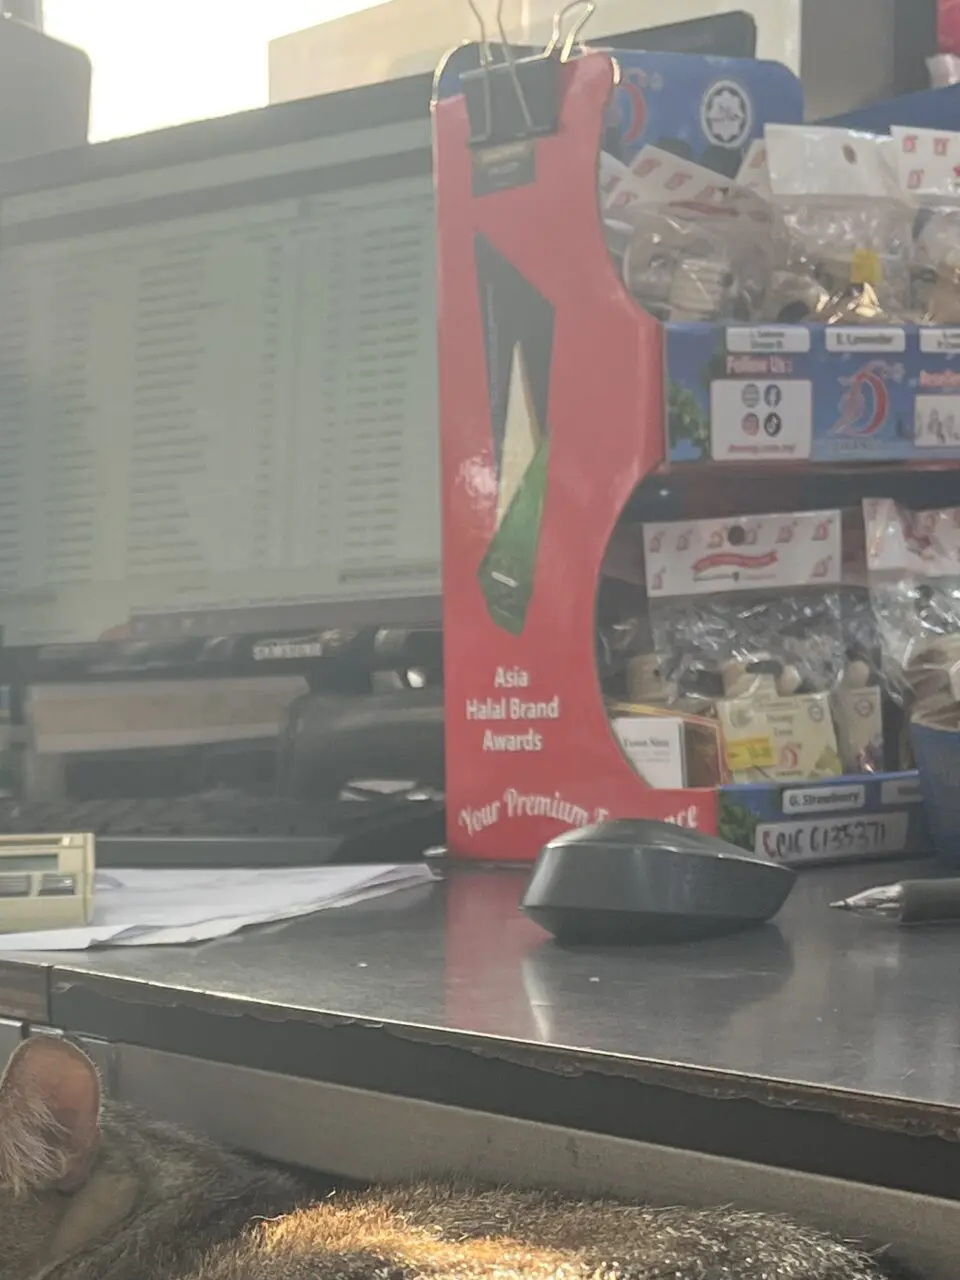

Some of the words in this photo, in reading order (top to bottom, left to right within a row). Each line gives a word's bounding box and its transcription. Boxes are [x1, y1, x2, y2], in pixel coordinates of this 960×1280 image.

[252, 642, 322, 661] SAMSUNG
[494, 666, 529, 688] Asia
[466, 698, 506, 721] Halal
[509, 696, 559, 720] Brand
[483, 729, 543, 751] Awards
[459, 799, 501, 837] Your
[503, 787, 588, 827] Premium
